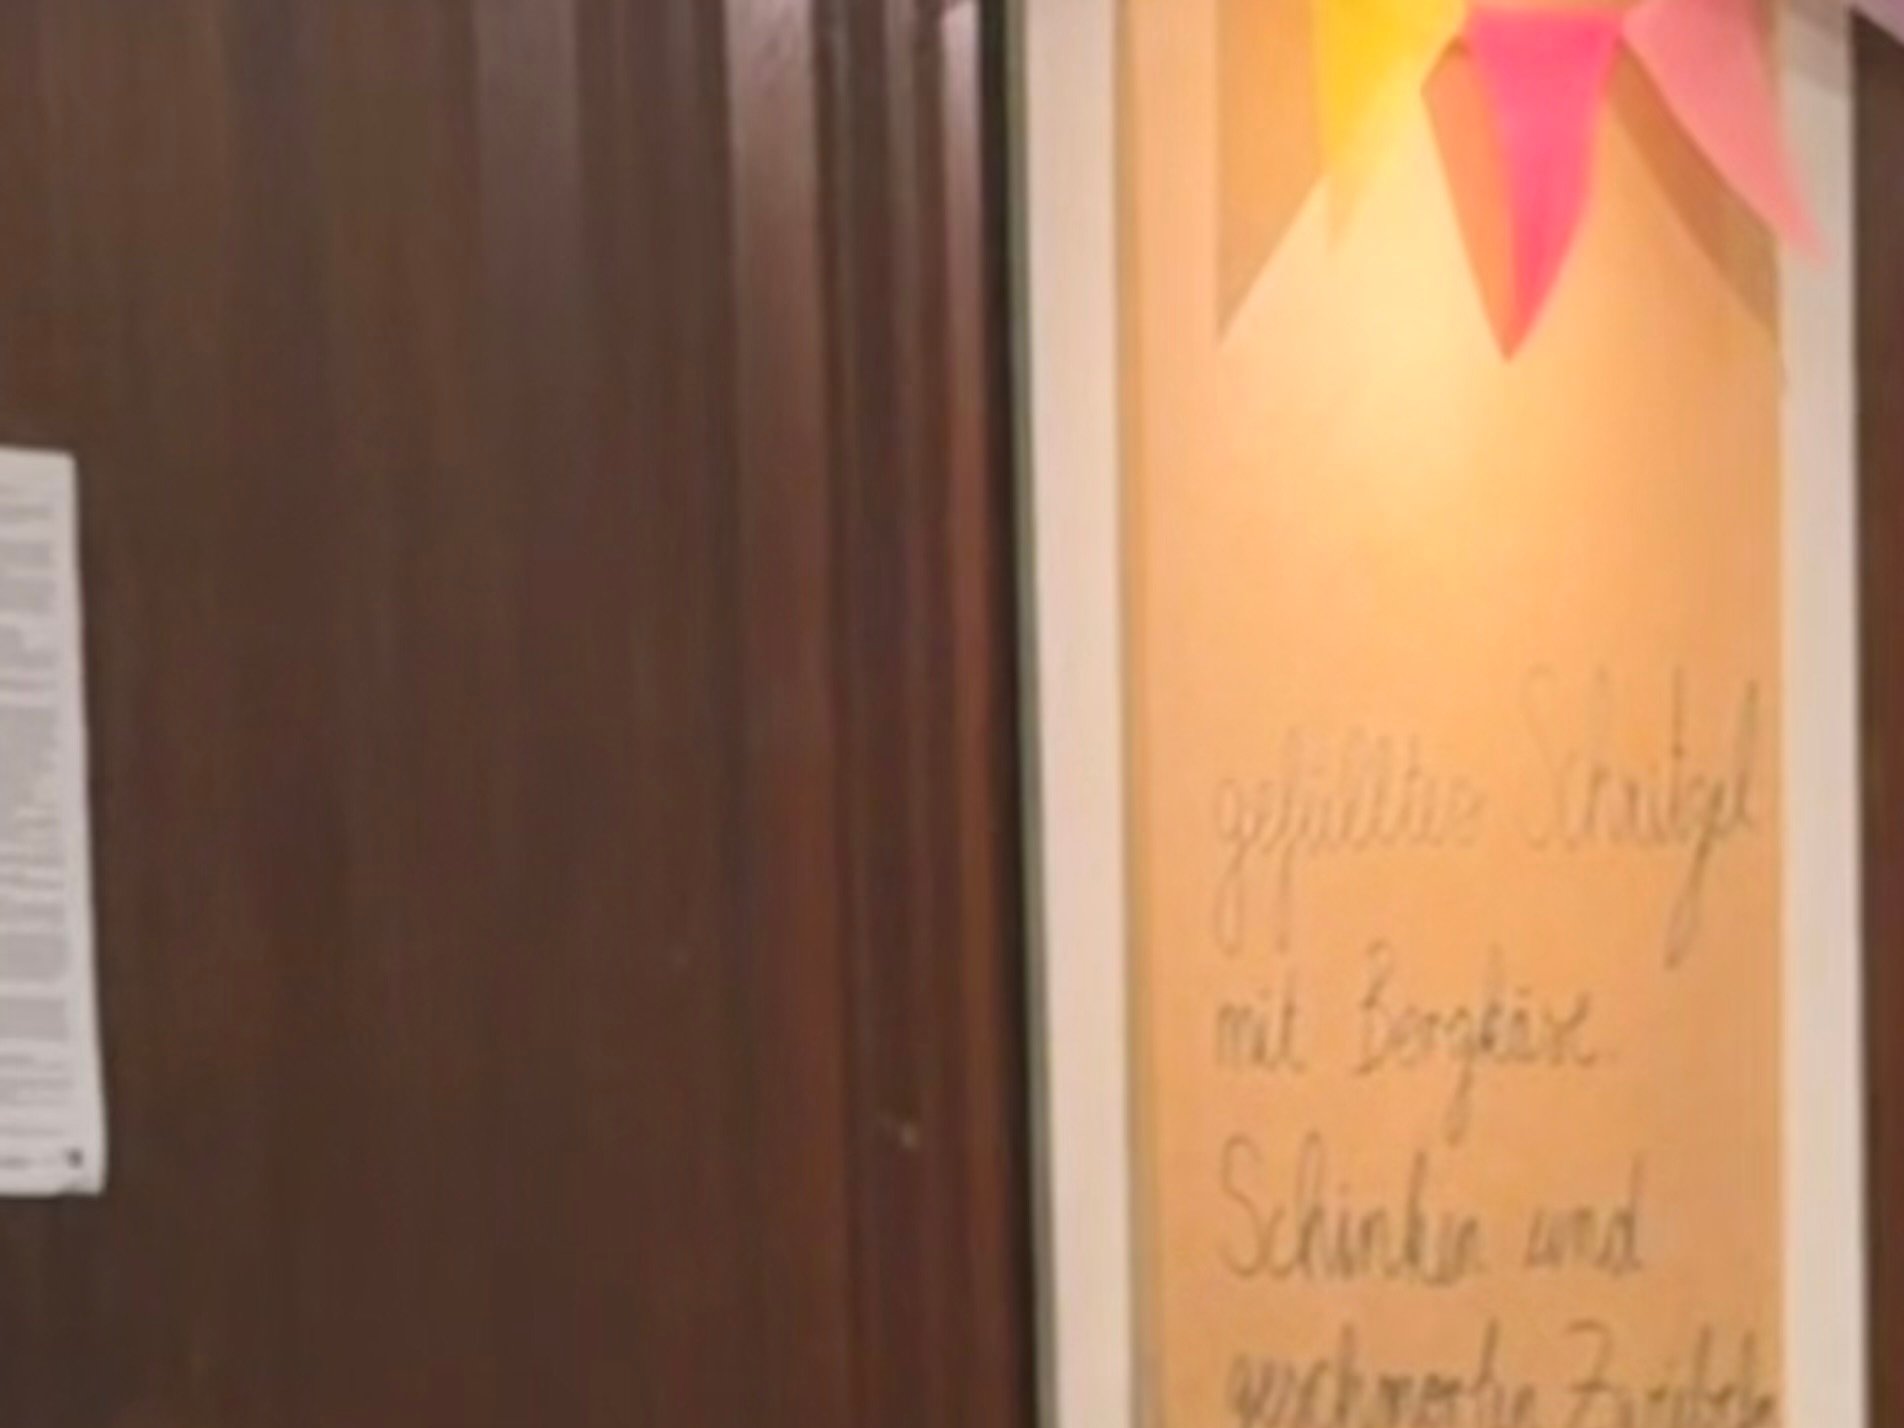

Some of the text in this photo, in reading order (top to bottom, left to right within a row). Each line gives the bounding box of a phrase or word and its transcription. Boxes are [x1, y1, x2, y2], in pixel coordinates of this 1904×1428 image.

[1215, 965, 1307, 1075] mit
[1220, 1130, 1644, 1286] Schinken und
